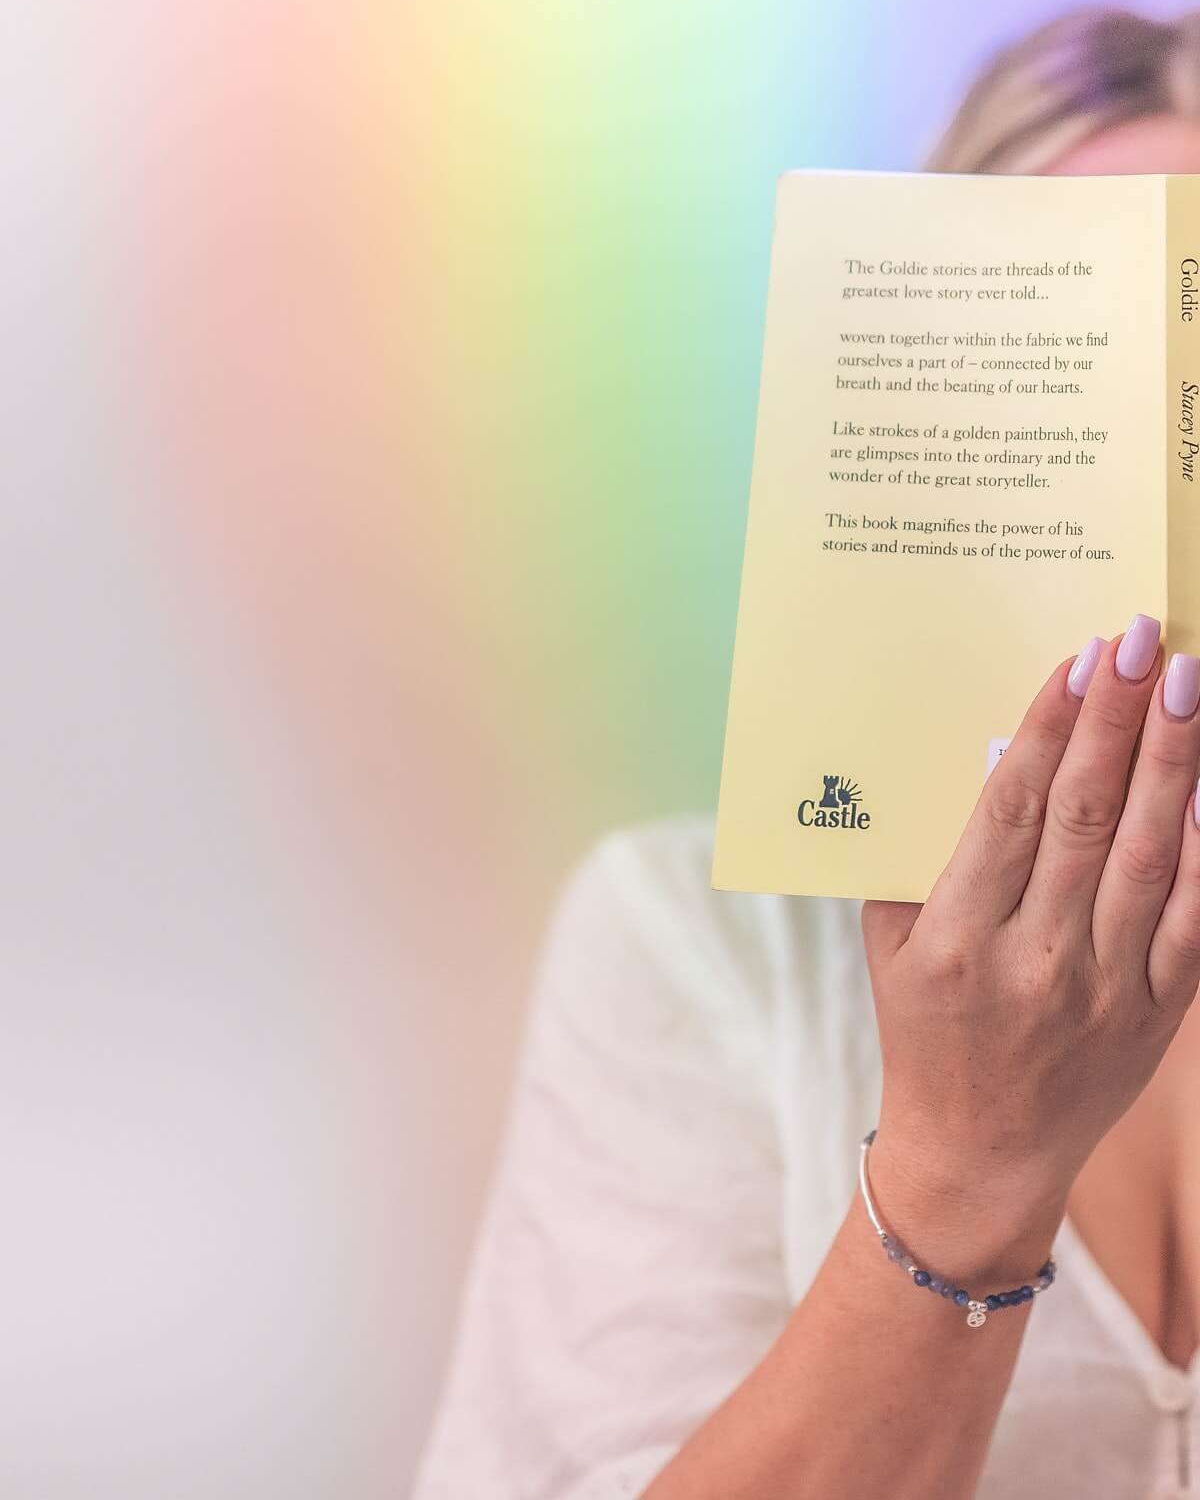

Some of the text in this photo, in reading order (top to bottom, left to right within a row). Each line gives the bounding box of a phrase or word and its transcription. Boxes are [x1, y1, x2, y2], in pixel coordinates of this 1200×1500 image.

[845, 260, 1093, 276] The Goldie stories are threads of the
[842, 284, 1049, 302] greatest love story ever told...
[1180, 258, 1199, 322] Goldie
[840, 332, 1108, 347] woven together within the fabric we find
[837, 354, 902, 368] ourselves
[907, 358, 914, 368] a
[919, 358, 945, 370] part
[951, 356, 966, 369] of
[981, 357, 1050, 370] connected
[1054, 357, 1069, 372] by
[1073, 359, 1093, 370] our
[836, 376, 1083, 395] breath and the beating of our hearts.
[832, 420, 1108, 443] Like strokes of a golden paintbrush, they
[1177, 381, 1200, 483] Stacey Pyne
[830, 447, 1096, 466] are glimpses into the ordinary and the
[829, 470, 1050, 489] wonder of the great storyteller.
[825, 513, 1083, 537] This book magnifies the power of his
[822, 538, 1114, 560] stories and reminds us of the power of ours.
[797, 799, 871, 830] Castle
